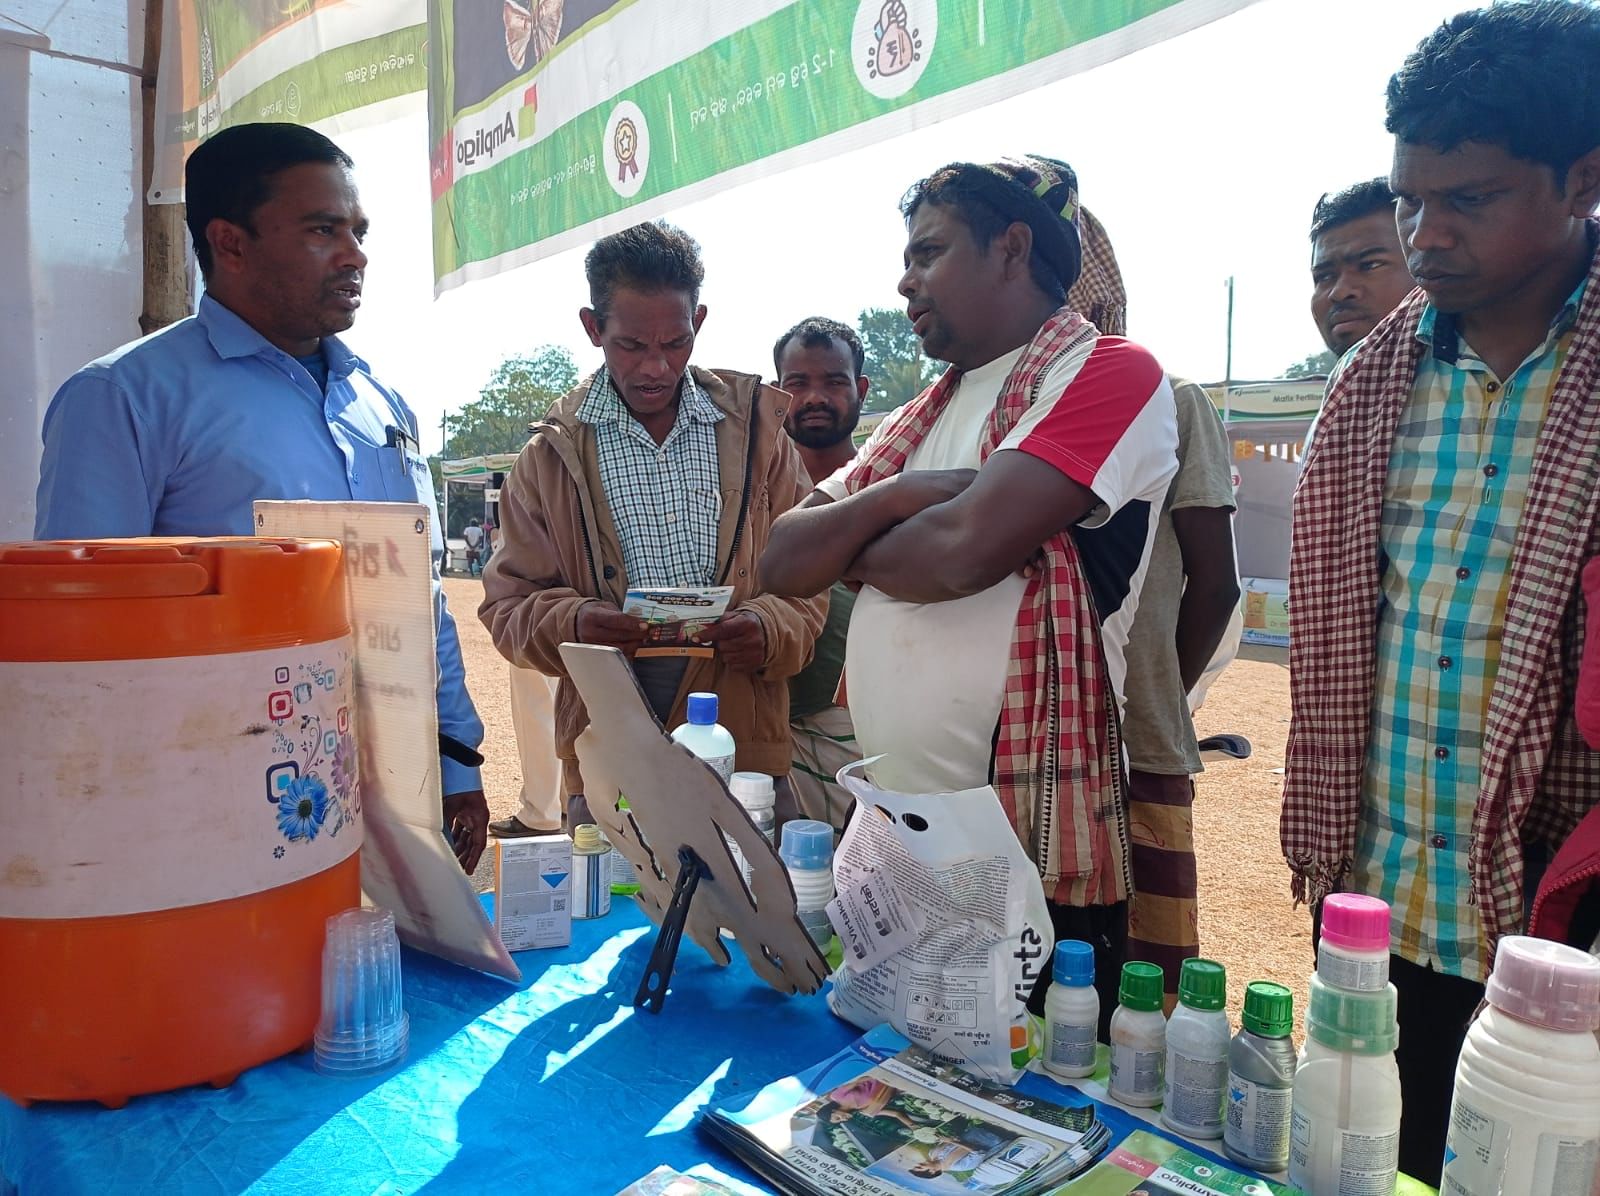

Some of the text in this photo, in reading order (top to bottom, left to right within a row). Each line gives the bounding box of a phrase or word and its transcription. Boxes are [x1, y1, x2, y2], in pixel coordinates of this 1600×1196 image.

[836, 899, 858, 940] Virtako
[932, 1053, 966, 1065] DANGER
[1161, 1172, 1226, 1196] Ampligo
